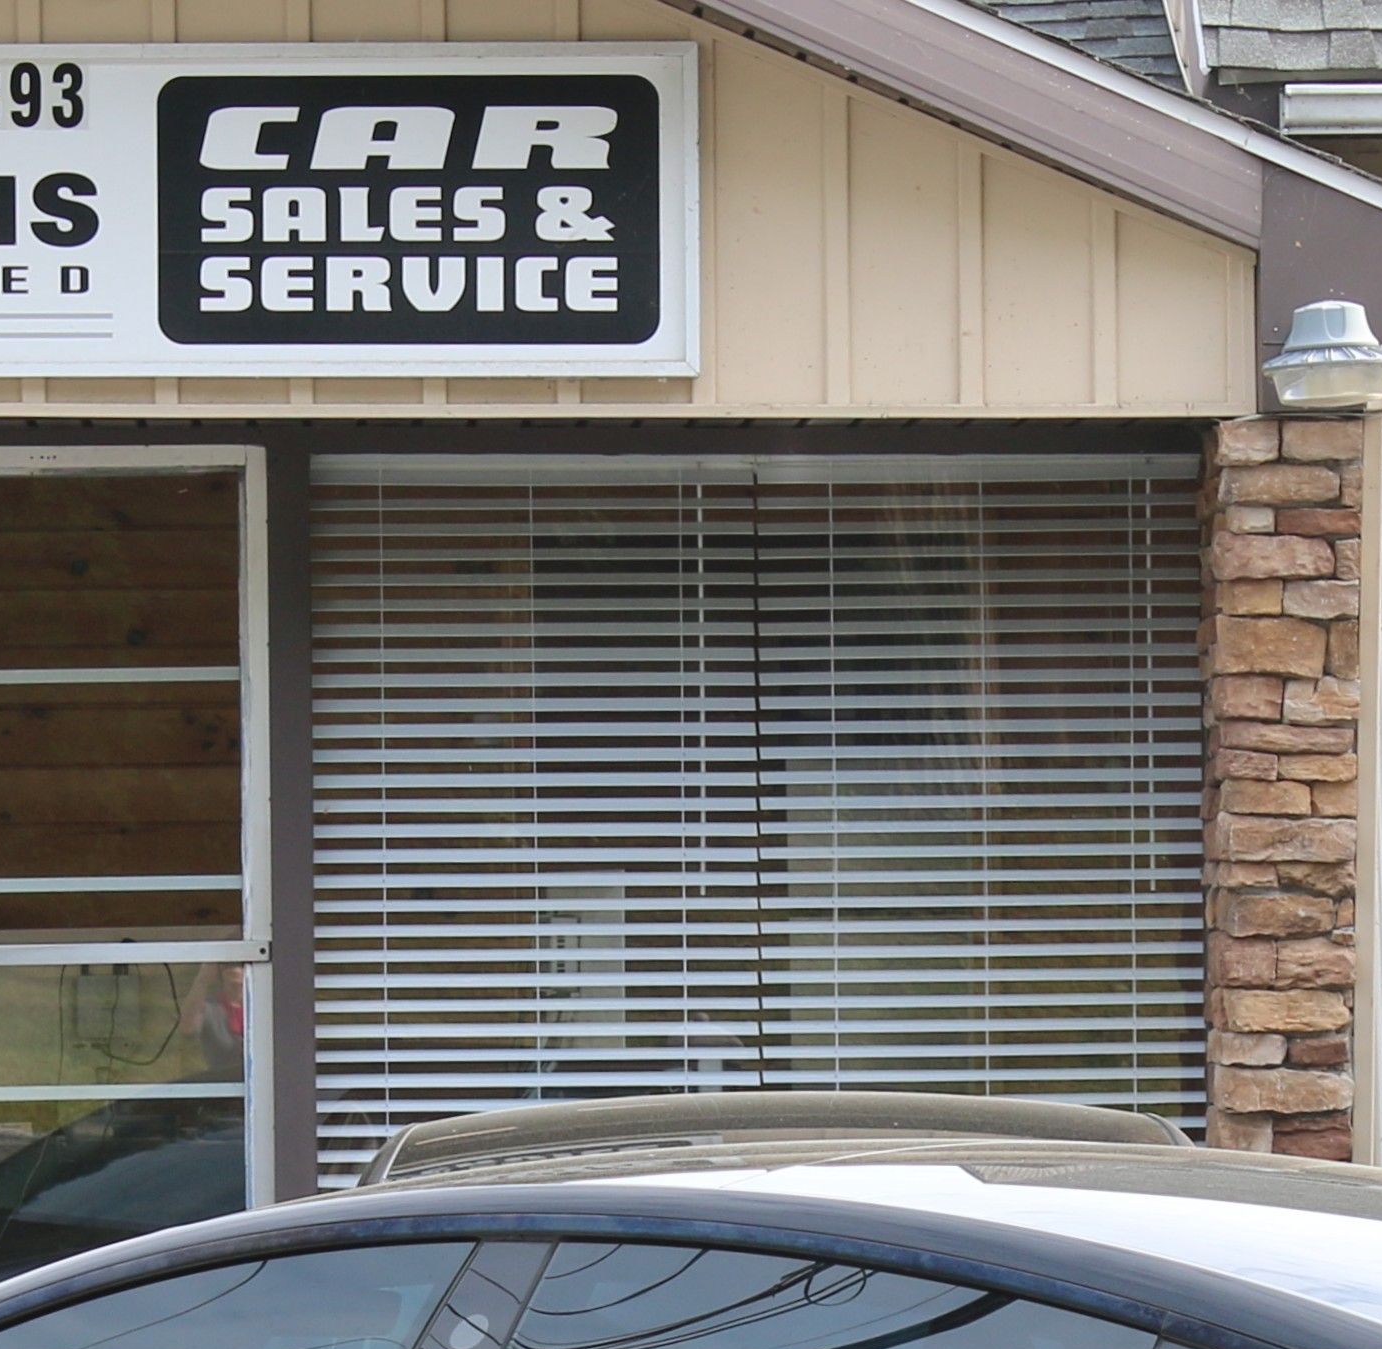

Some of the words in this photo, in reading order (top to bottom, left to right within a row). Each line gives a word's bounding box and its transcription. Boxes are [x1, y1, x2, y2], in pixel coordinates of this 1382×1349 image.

[199, 105, 618, 170] CAR
[200, 186, 506, 243] SALES
[535, 186, 616, 242] &
[199, 256, 618, 312] SERVICE
